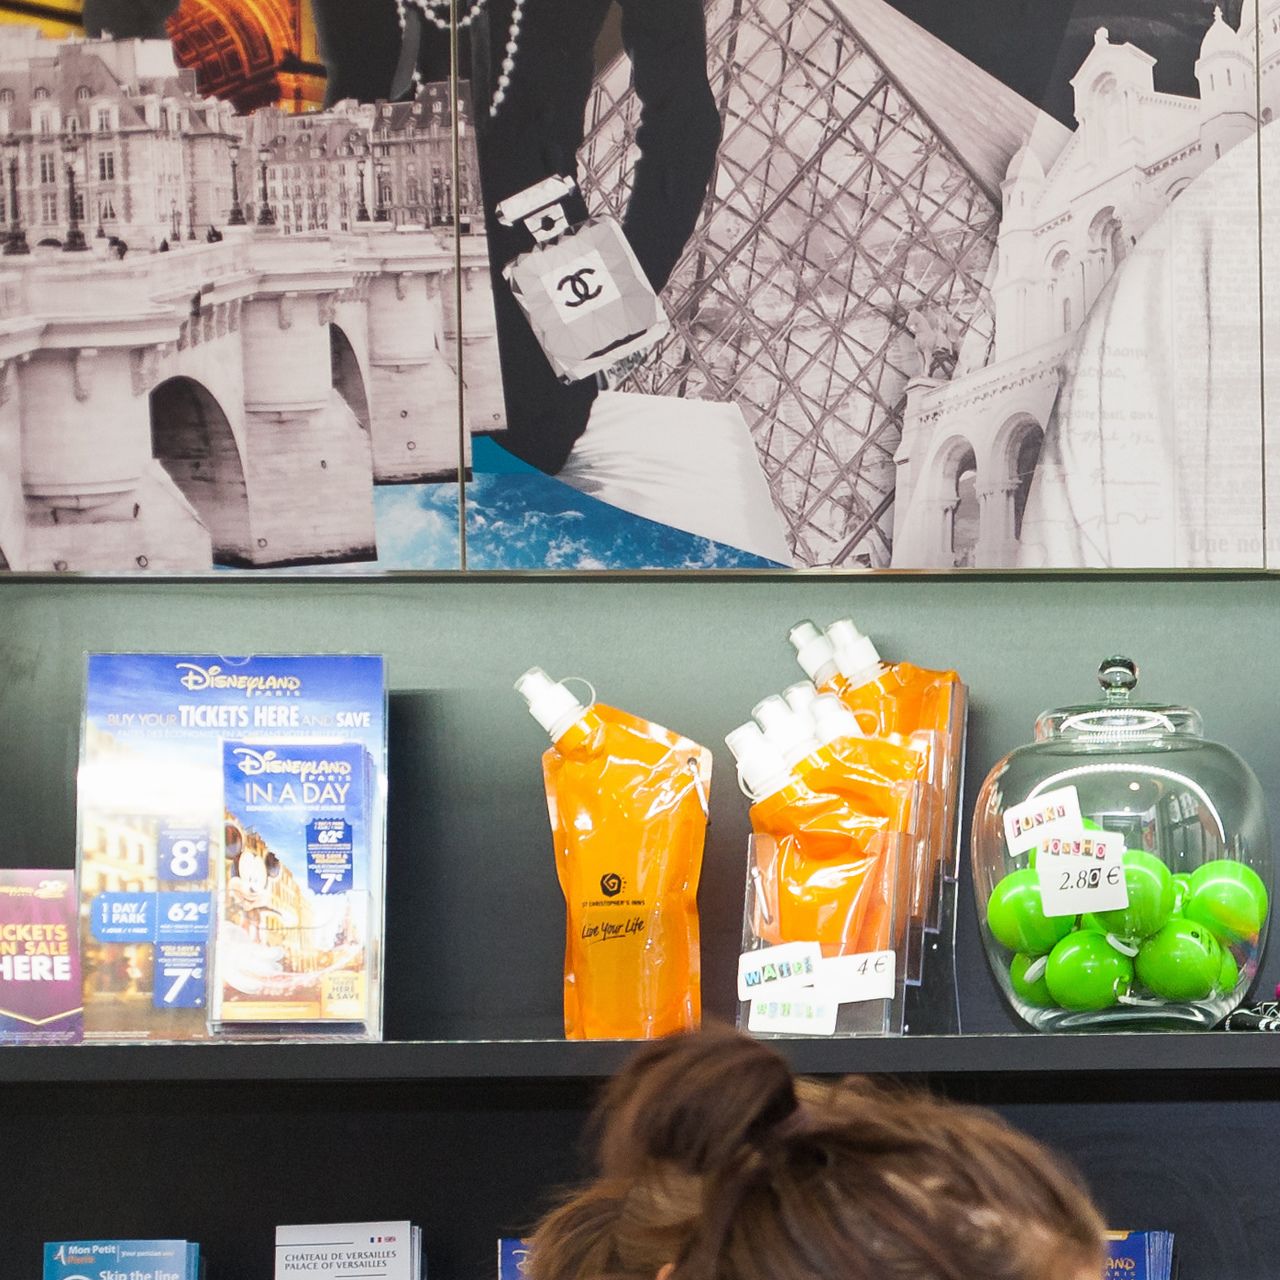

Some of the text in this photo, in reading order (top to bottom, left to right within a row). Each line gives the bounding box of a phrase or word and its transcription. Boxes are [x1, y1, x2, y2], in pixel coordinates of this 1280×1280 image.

[107, 705, 370, 728] BUY YOUR TICKETS HERE AND SAVE
[245, 782, 351, 805] IN A DAY
[102, 902, 107, 913] 1
[112, 902, 138, 913] DAY
[167, 902, 208, 922] 62€
[102, 913, 146, 924] 1 PARK
[582, 916, 646, 942] Live Your Life
[0, 942, 69, 956] N SALE
[0, 955, 72, 981] HERE
[68, 1245, 116, 1254] Mon Petit
[330, 1252, 343, 1260] DE
[346, 1250, 397, 1260] VERSAILLES
[284, 1260, 388, 1270] PALACE OF VERSAILLES
